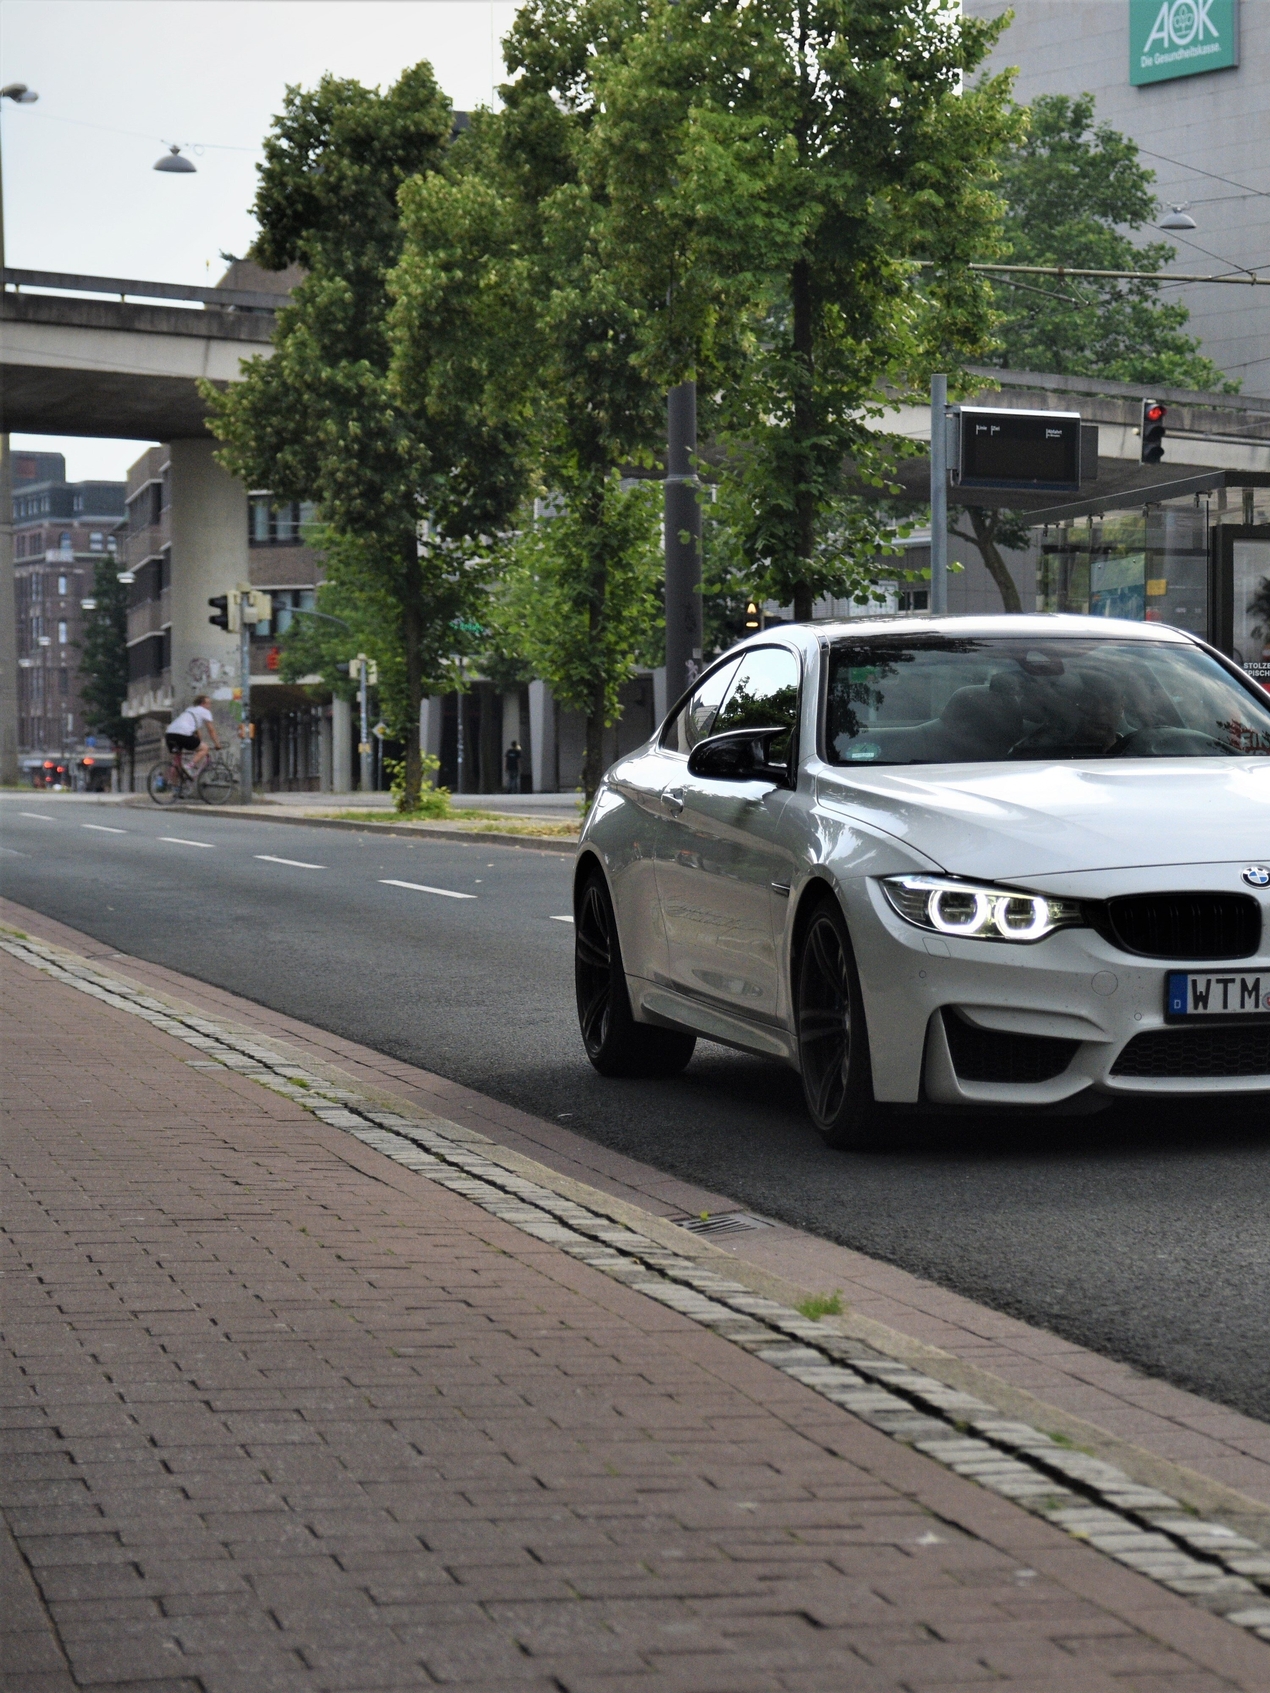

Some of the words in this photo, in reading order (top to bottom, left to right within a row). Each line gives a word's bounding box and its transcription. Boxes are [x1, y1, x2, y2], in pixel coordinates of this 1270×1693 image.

[1143, 0, 1219, 53] AOK
[1141, 55, 1153, 68] Die
[1174, 1000, 1181, 1009] D
[1191, 977, 1261, 1010] WTM
